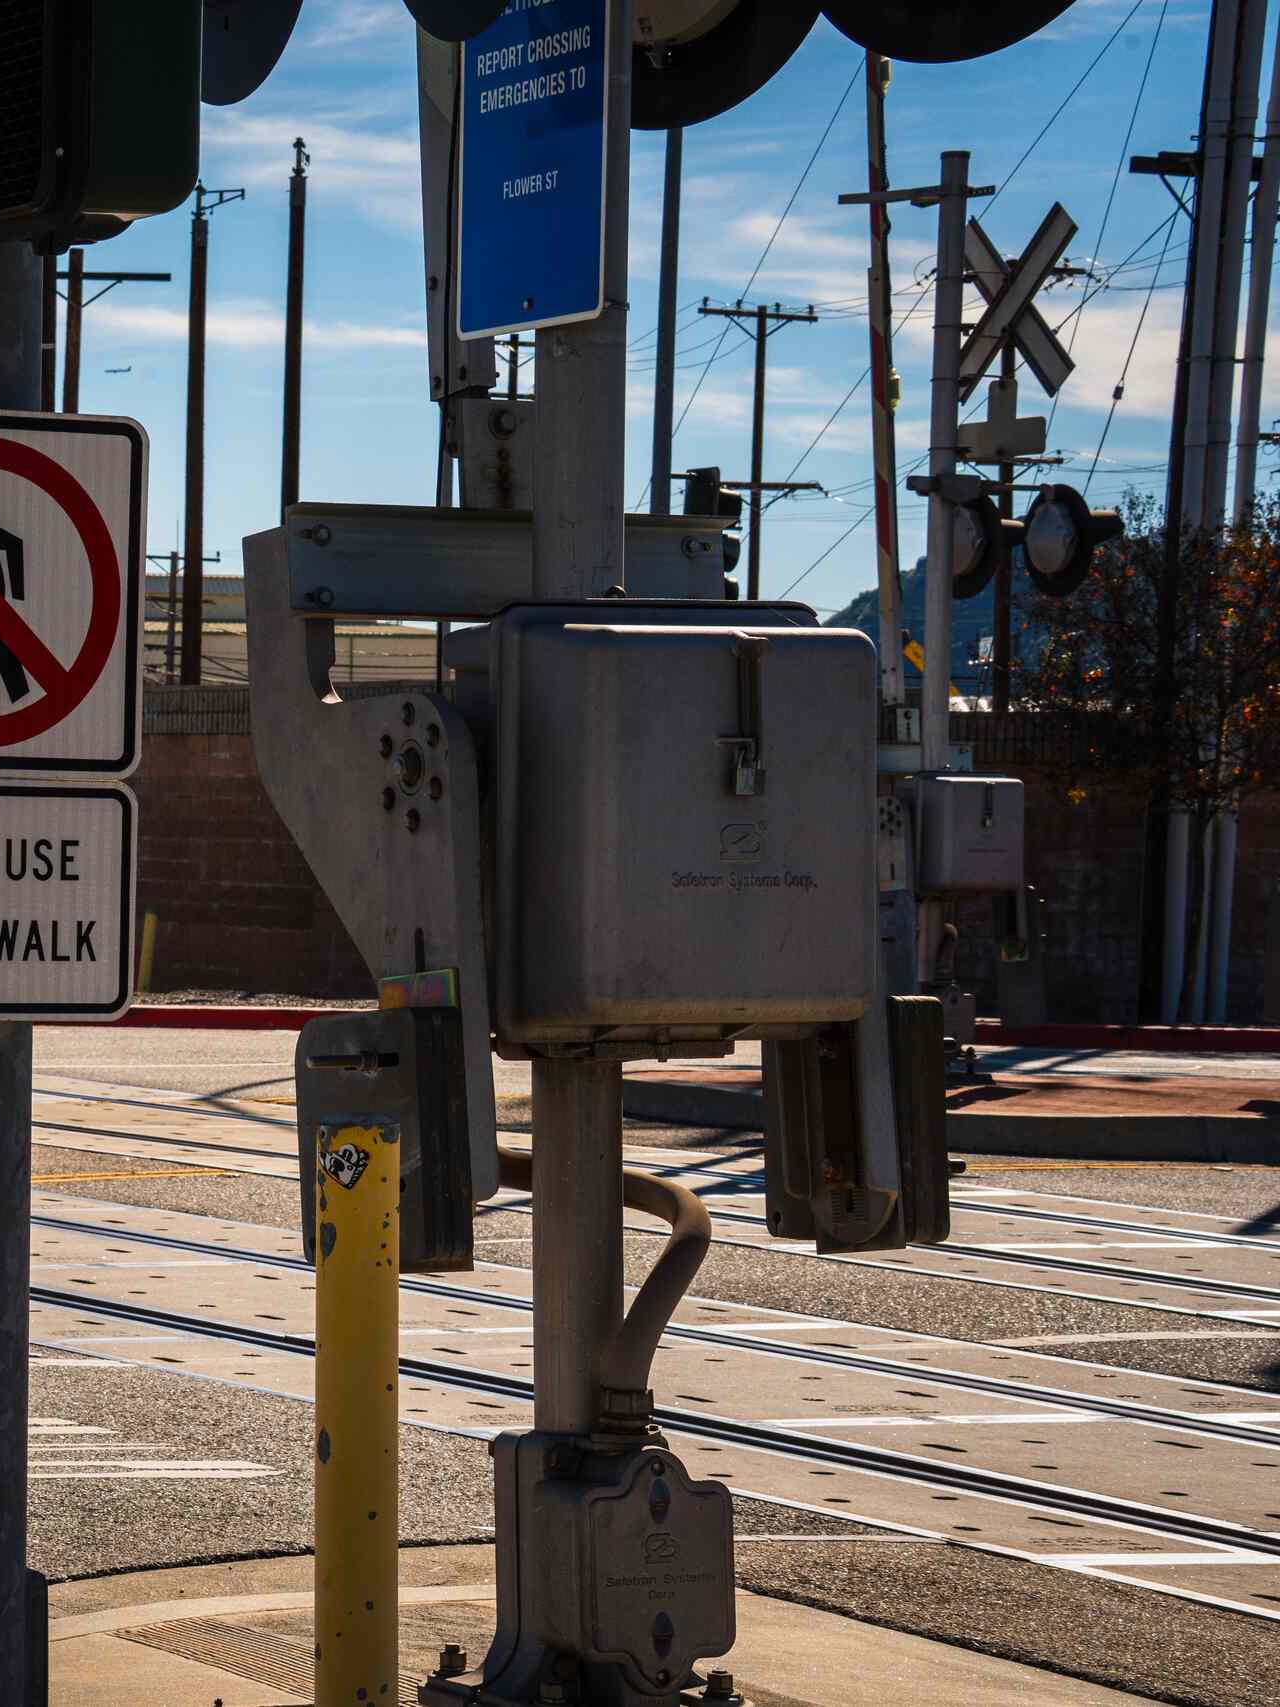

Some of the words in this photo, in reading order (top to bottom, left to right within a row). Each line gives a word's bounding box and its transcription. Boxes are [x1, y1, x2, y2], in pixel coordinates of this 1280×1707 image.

[477, 44, 524, 77] REPORT
[527, 25, 591, 64] CROSSING
[480, 73, 566, 114] EMERGENCIES
[570, 66, 586, 91] TO
[503, 174, 543, 200] FLOWER
[545, 170, 559, 190] ST
[5, 838, 80, 881] USE
